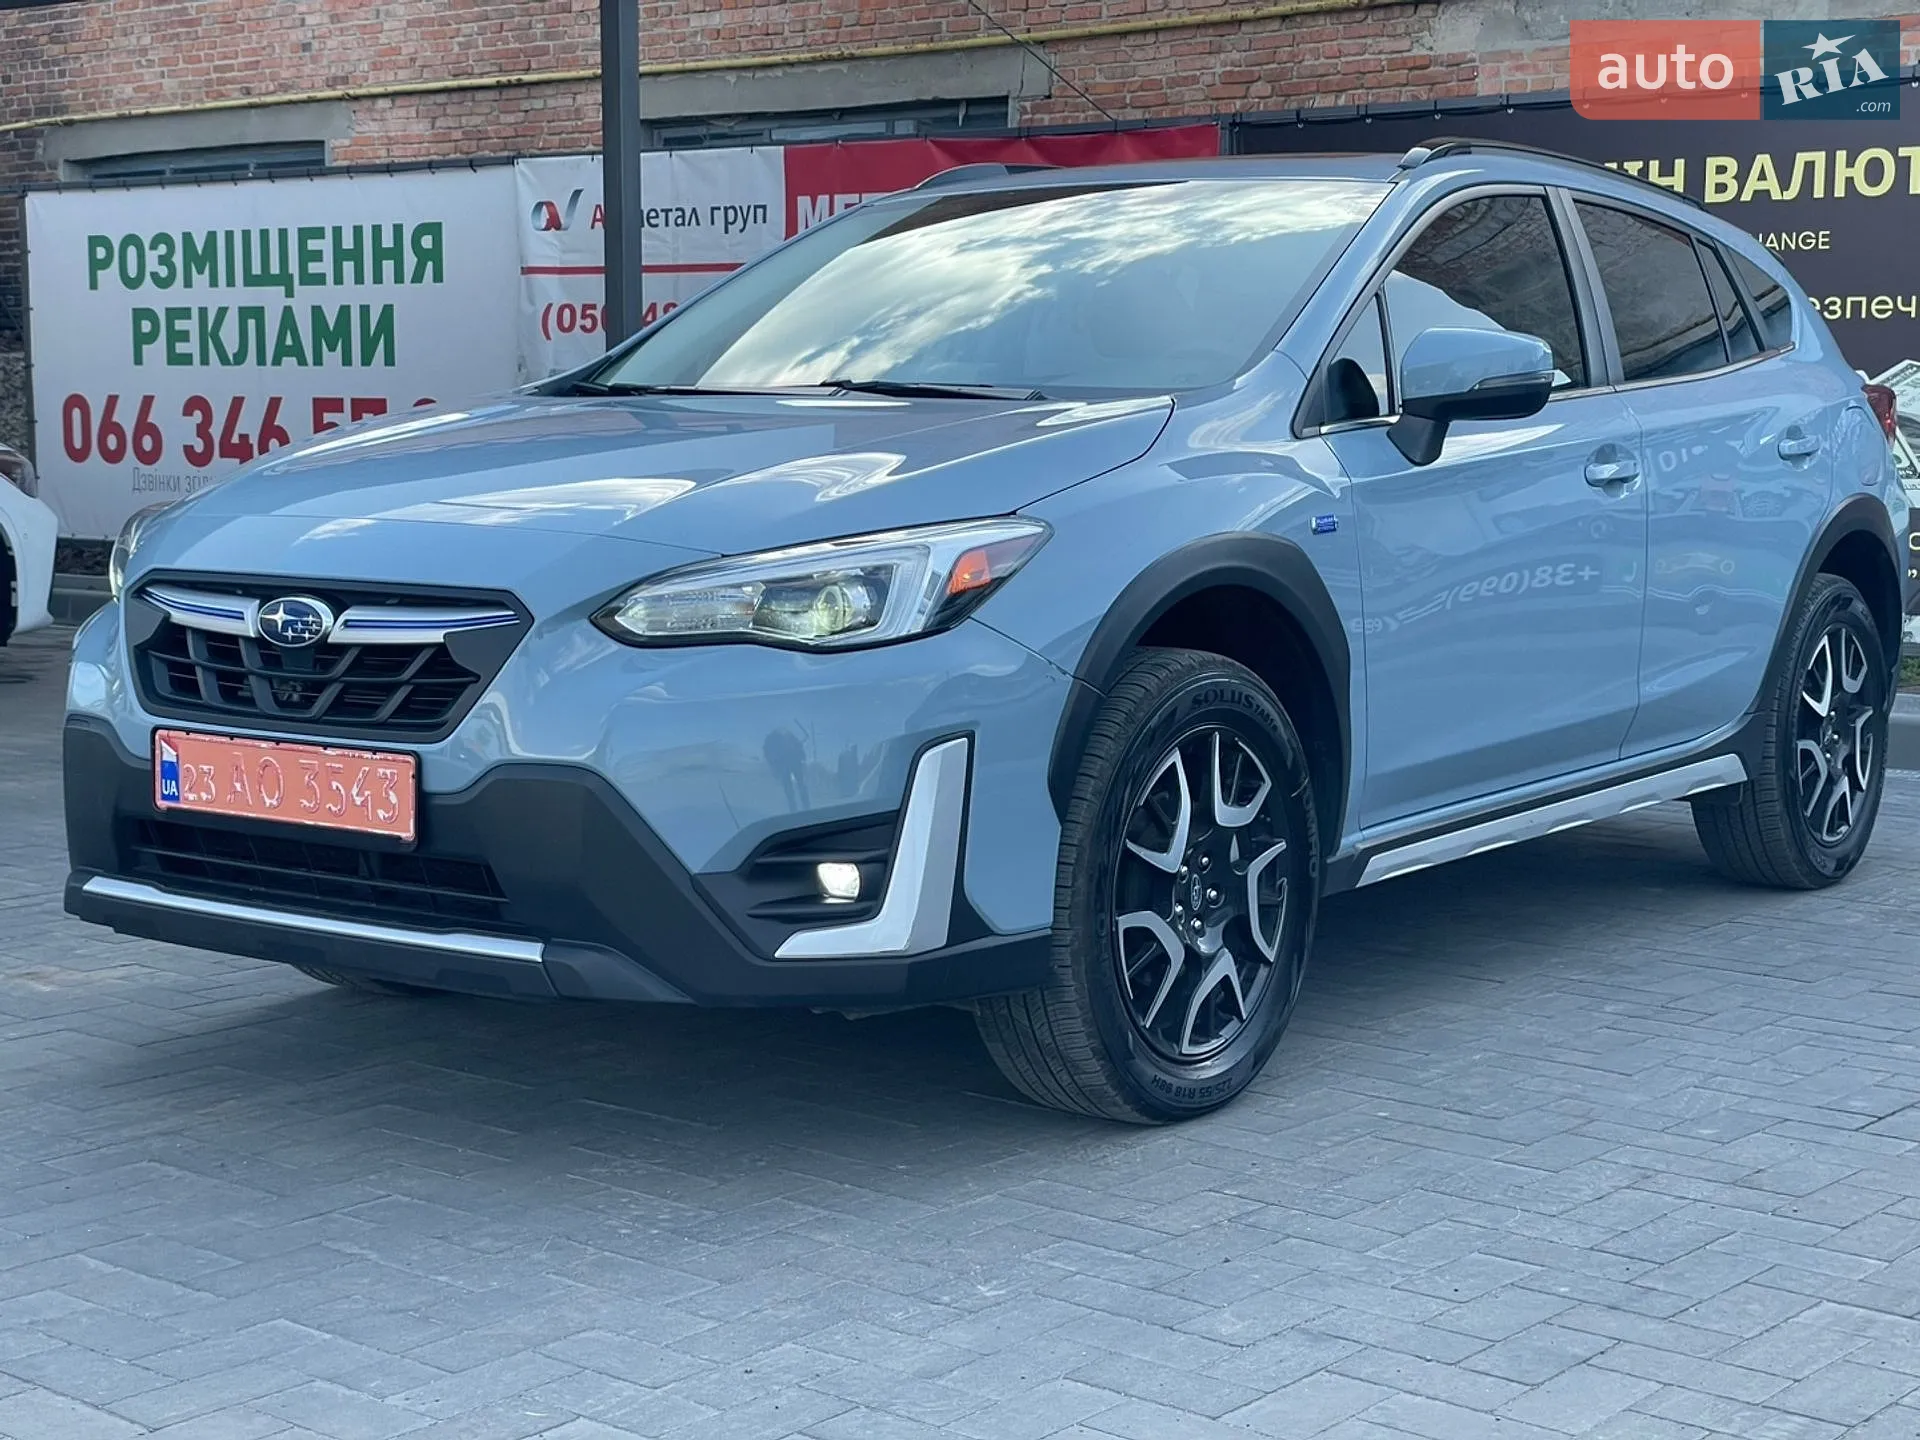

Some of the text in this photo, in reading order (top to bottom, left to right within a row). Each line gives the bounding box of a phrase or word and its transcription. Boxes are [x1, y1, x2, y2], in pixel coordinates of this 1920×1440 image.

[709, 203, 768, 235] груп
[87, 221, 444, 299] РОЗМІЩЕННЯ
[131, 304, 396, 368] РЕКЛАМИ
[62, 392, 163, 466] 066
[182, 394, 291, 468] 346
[132, 467, 181, 494] Дзвінки
[162, 778, 179, 796] UA
[183, 762, 217, 803] 23
[299, 759, 400, 824] 3543
